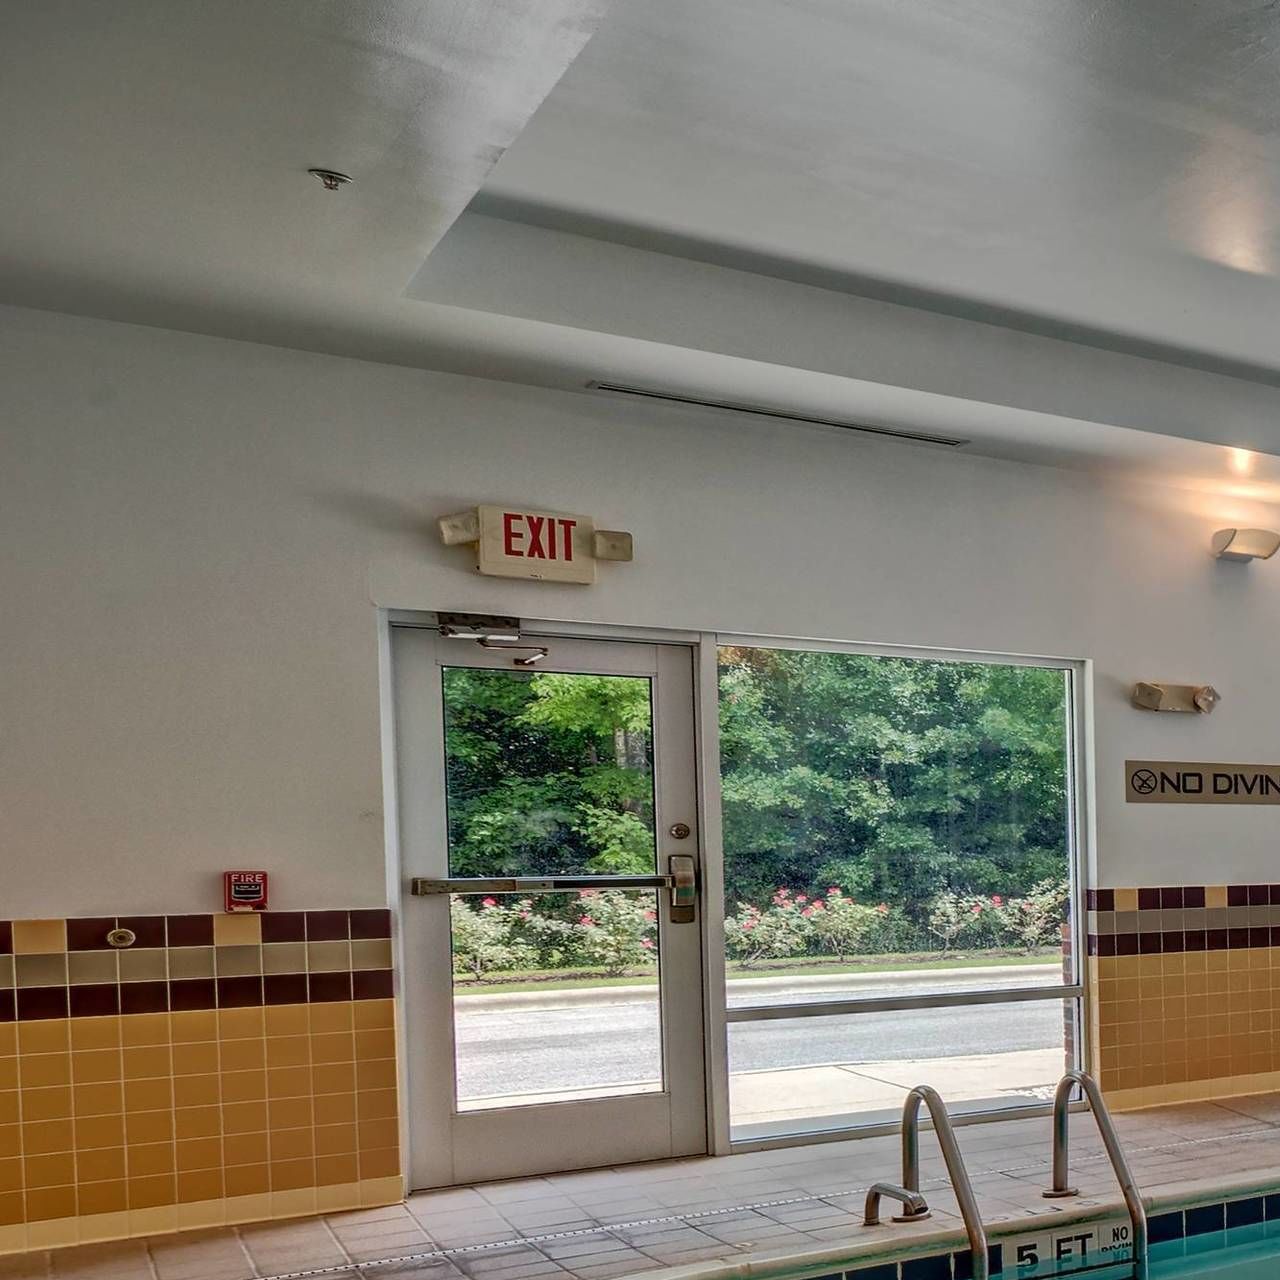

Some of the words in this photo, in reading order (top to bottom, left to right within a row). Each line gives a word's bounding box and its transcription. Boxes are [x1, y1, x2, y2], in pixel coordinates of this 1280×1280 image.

[503, 513, 576, 561] EXIT
[1160, 772, 1203, 793] NO
[231, 874, 263, 883] FIRE
[1112, 1226, 1129, 1242] NO
[1017, 1243, 1039, 1267] 5
[1056, 1233, 1093, 1263] FT
